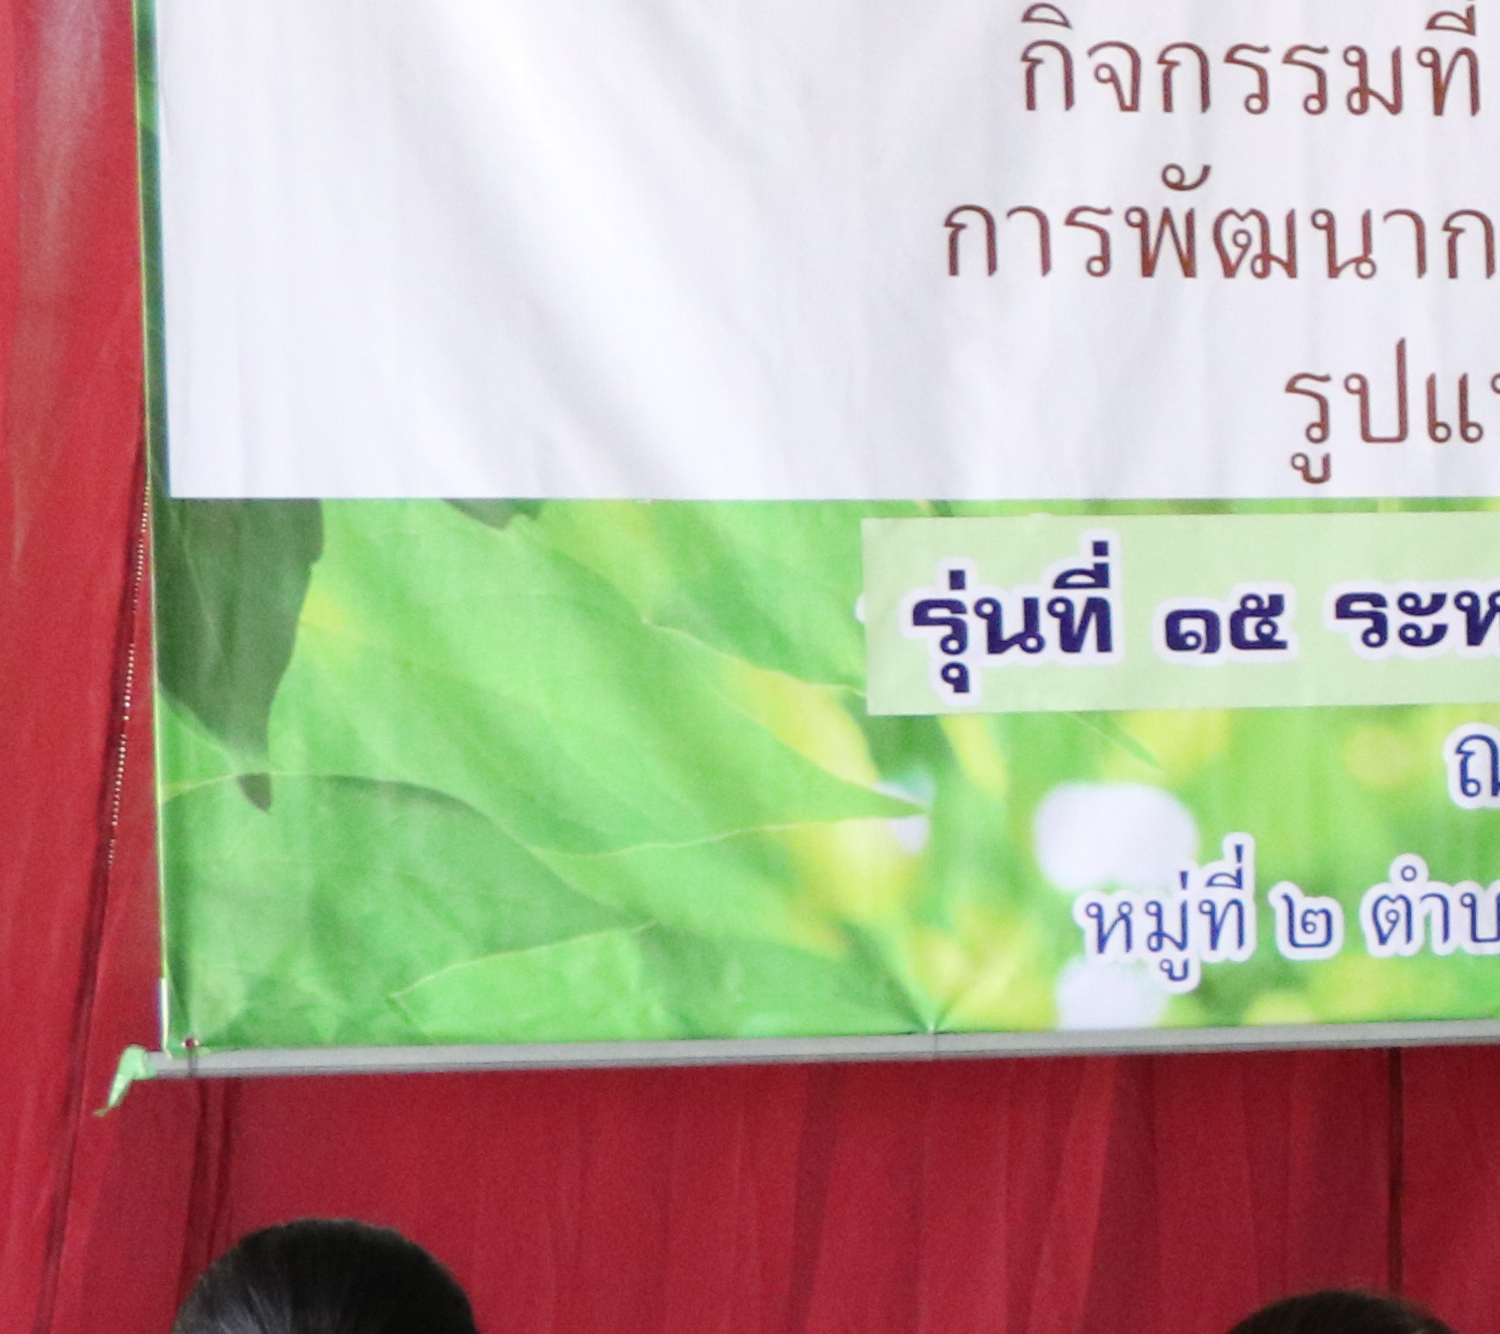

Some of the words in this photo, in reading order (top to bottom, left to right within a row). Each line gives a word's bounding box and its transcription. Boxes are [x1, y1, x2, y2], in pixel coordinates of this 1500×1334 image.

[912, 541, 1113, 693] รุ่นที่
[1165, 593, 1287, 654] ๑๕
[1085, 844, 1245, 982] หมู่ที่
[1282, 893, 1334, 949] ๒
